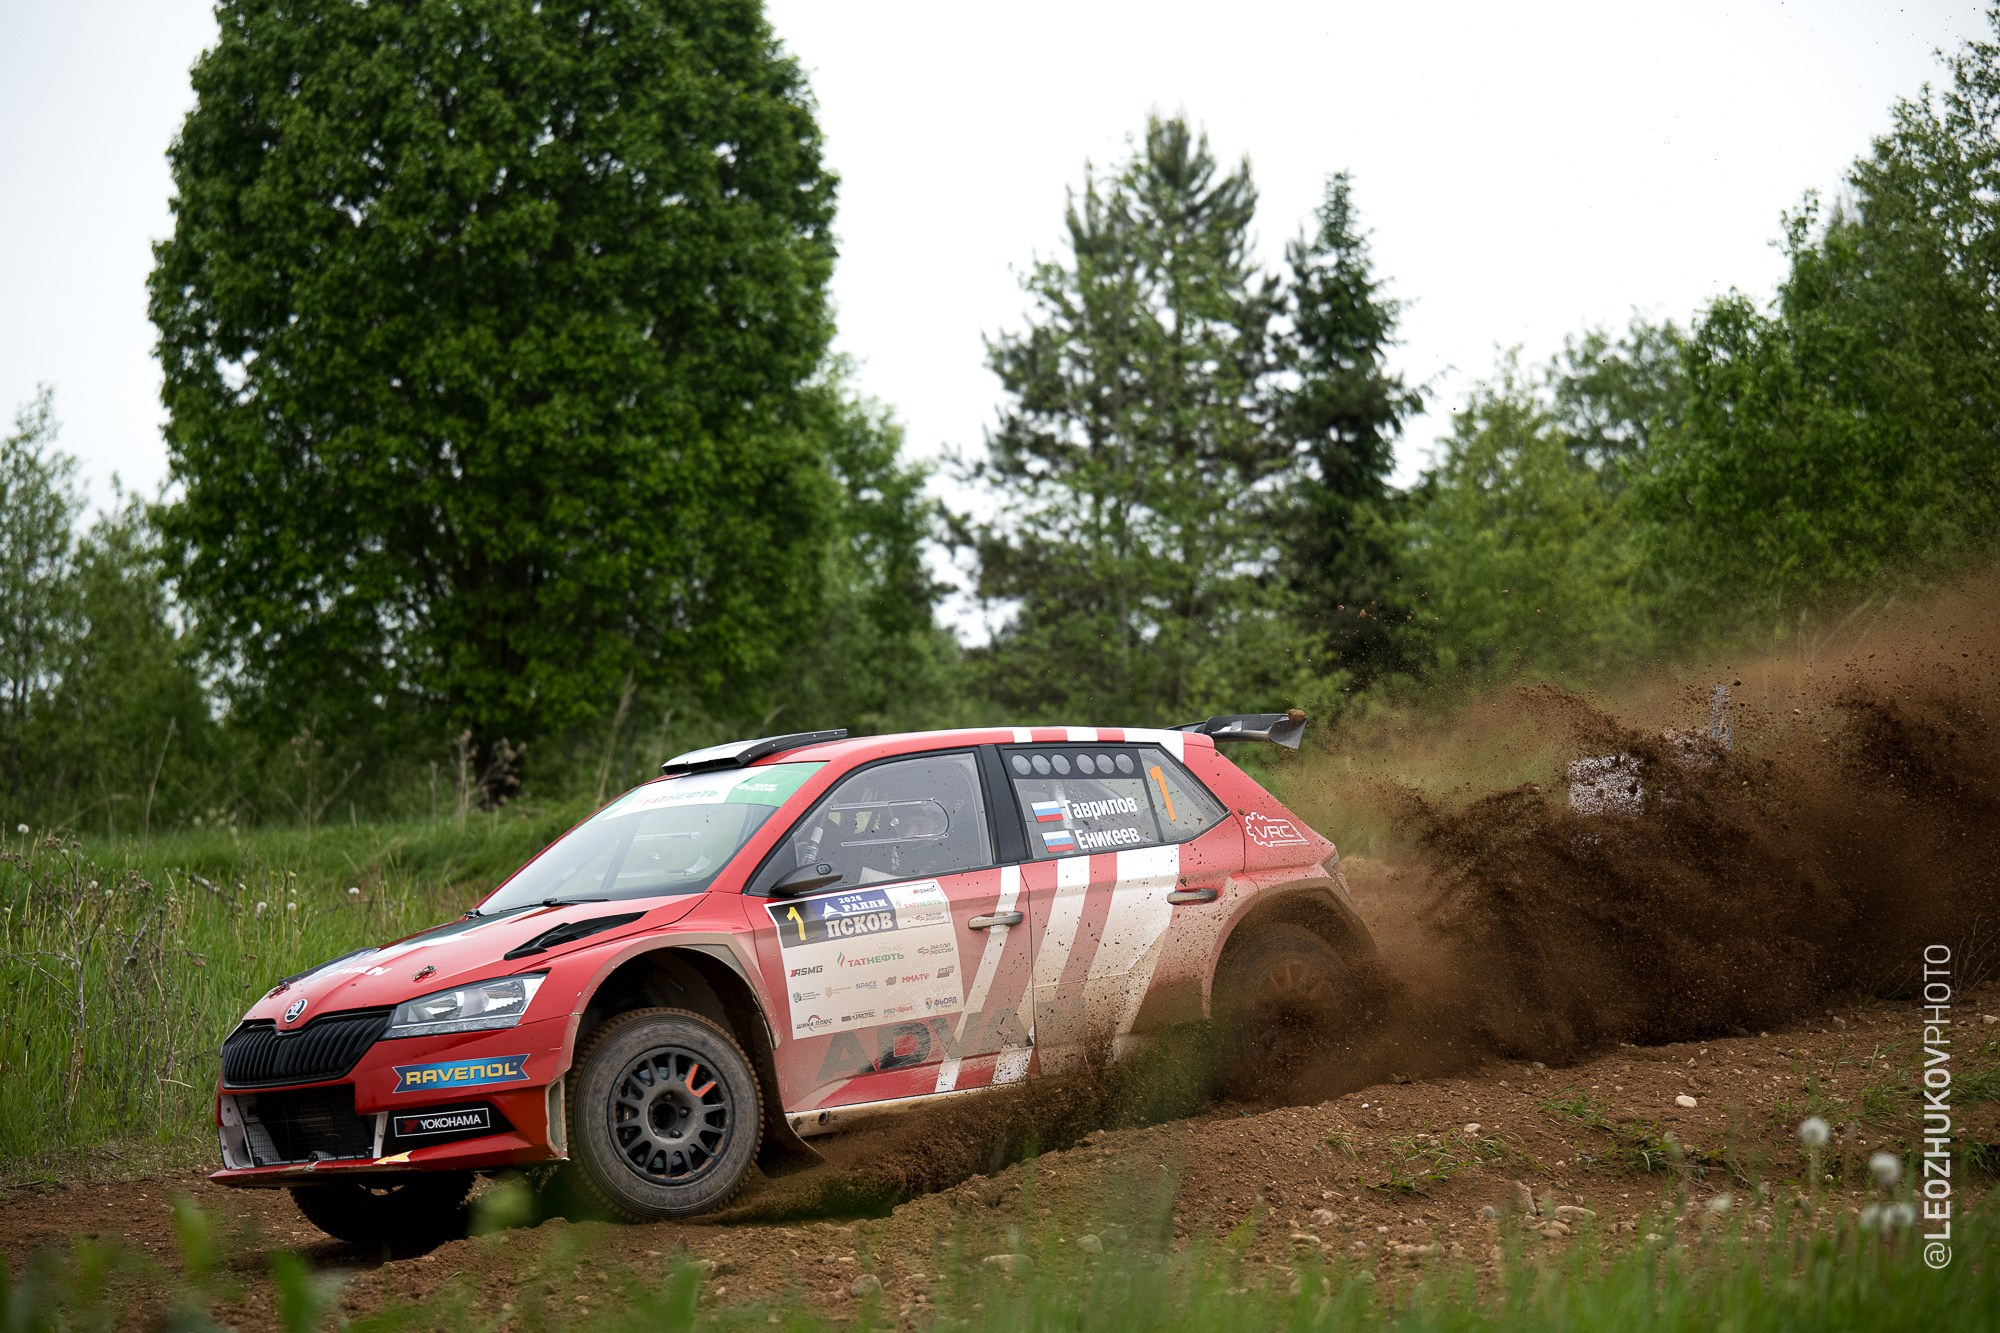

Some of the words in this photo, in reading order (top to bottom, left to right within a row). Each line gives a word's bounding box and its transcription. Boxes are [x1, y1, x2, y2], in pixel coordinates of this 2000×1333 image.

[1149, 765, 1177, 821] 1
[1064, 797, 1138, 820] Гаврилов
[1074, 827, 1140, 850] Еникеев
[1254, 825, 1295, 838] VRC
[838, 894, 862, 904] 2026
[841, 899, 887, 912] РАЛЛИ
[786, 906, 806, 940] 1
[826, 912, 893, 938] ПСКОВ
[847, 953, 904, 969] ТАТНЕФТЬ
[856, 981, 878, 989] SPACE
[934, 997, 957, 1006] ФЬОРД
[406, 1062, 518, 1085] RAVENOL
[420, 1114, 482, 1130] YOKOHAMA
